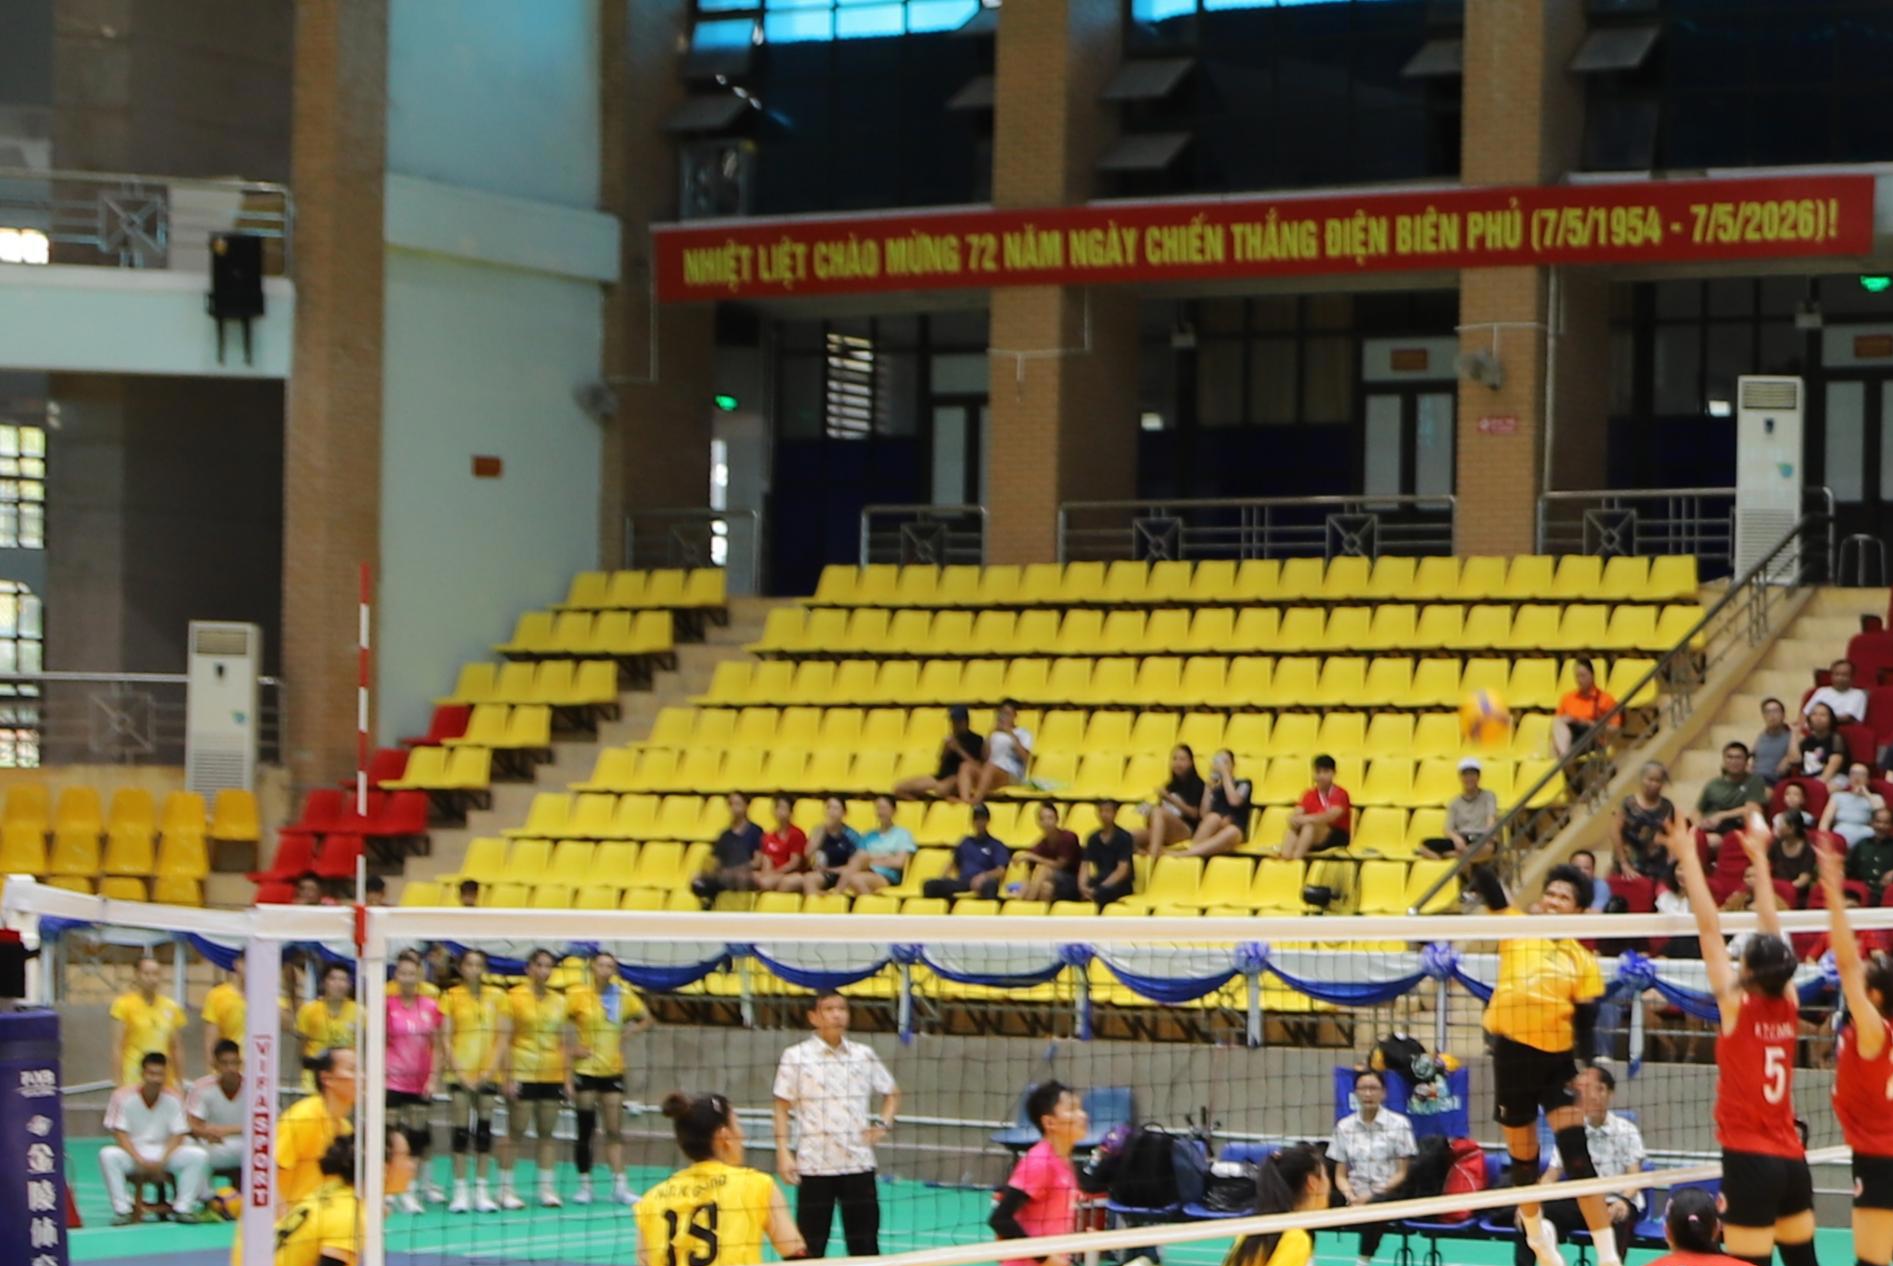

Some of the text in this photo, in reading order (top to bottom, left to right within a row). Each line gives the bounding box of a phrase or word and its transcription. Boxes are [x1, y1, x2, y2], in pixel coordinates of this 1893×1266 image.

[683, 239, 752, 292] NHIỆT
[758, 235, 806, 289] LIỆT
[813, 233, 878, 279] CHÀO
[885, 229, 961, 274] MỪNG
[965, 233, 998, 271] 72
[1003, 223, 1063, 269] NĂM
[1069, 220, 1138, 267] NGÀY
[1144, 213, 1226, 265] CHIẾN
[1231, 207, 1318, 261] THẮNG
[1324, 209, 1389, 266] ĐIỆN
[1395, 207, 1462, 252] BIÊN
[1466, 198, 1523, 249] PHỦ
[1530, 206, 1663, 249] (7/5/1954
[1689, 199, 1838, 244] 7/5/2026)!
[1763, 1046, 1787, 1104] 5
